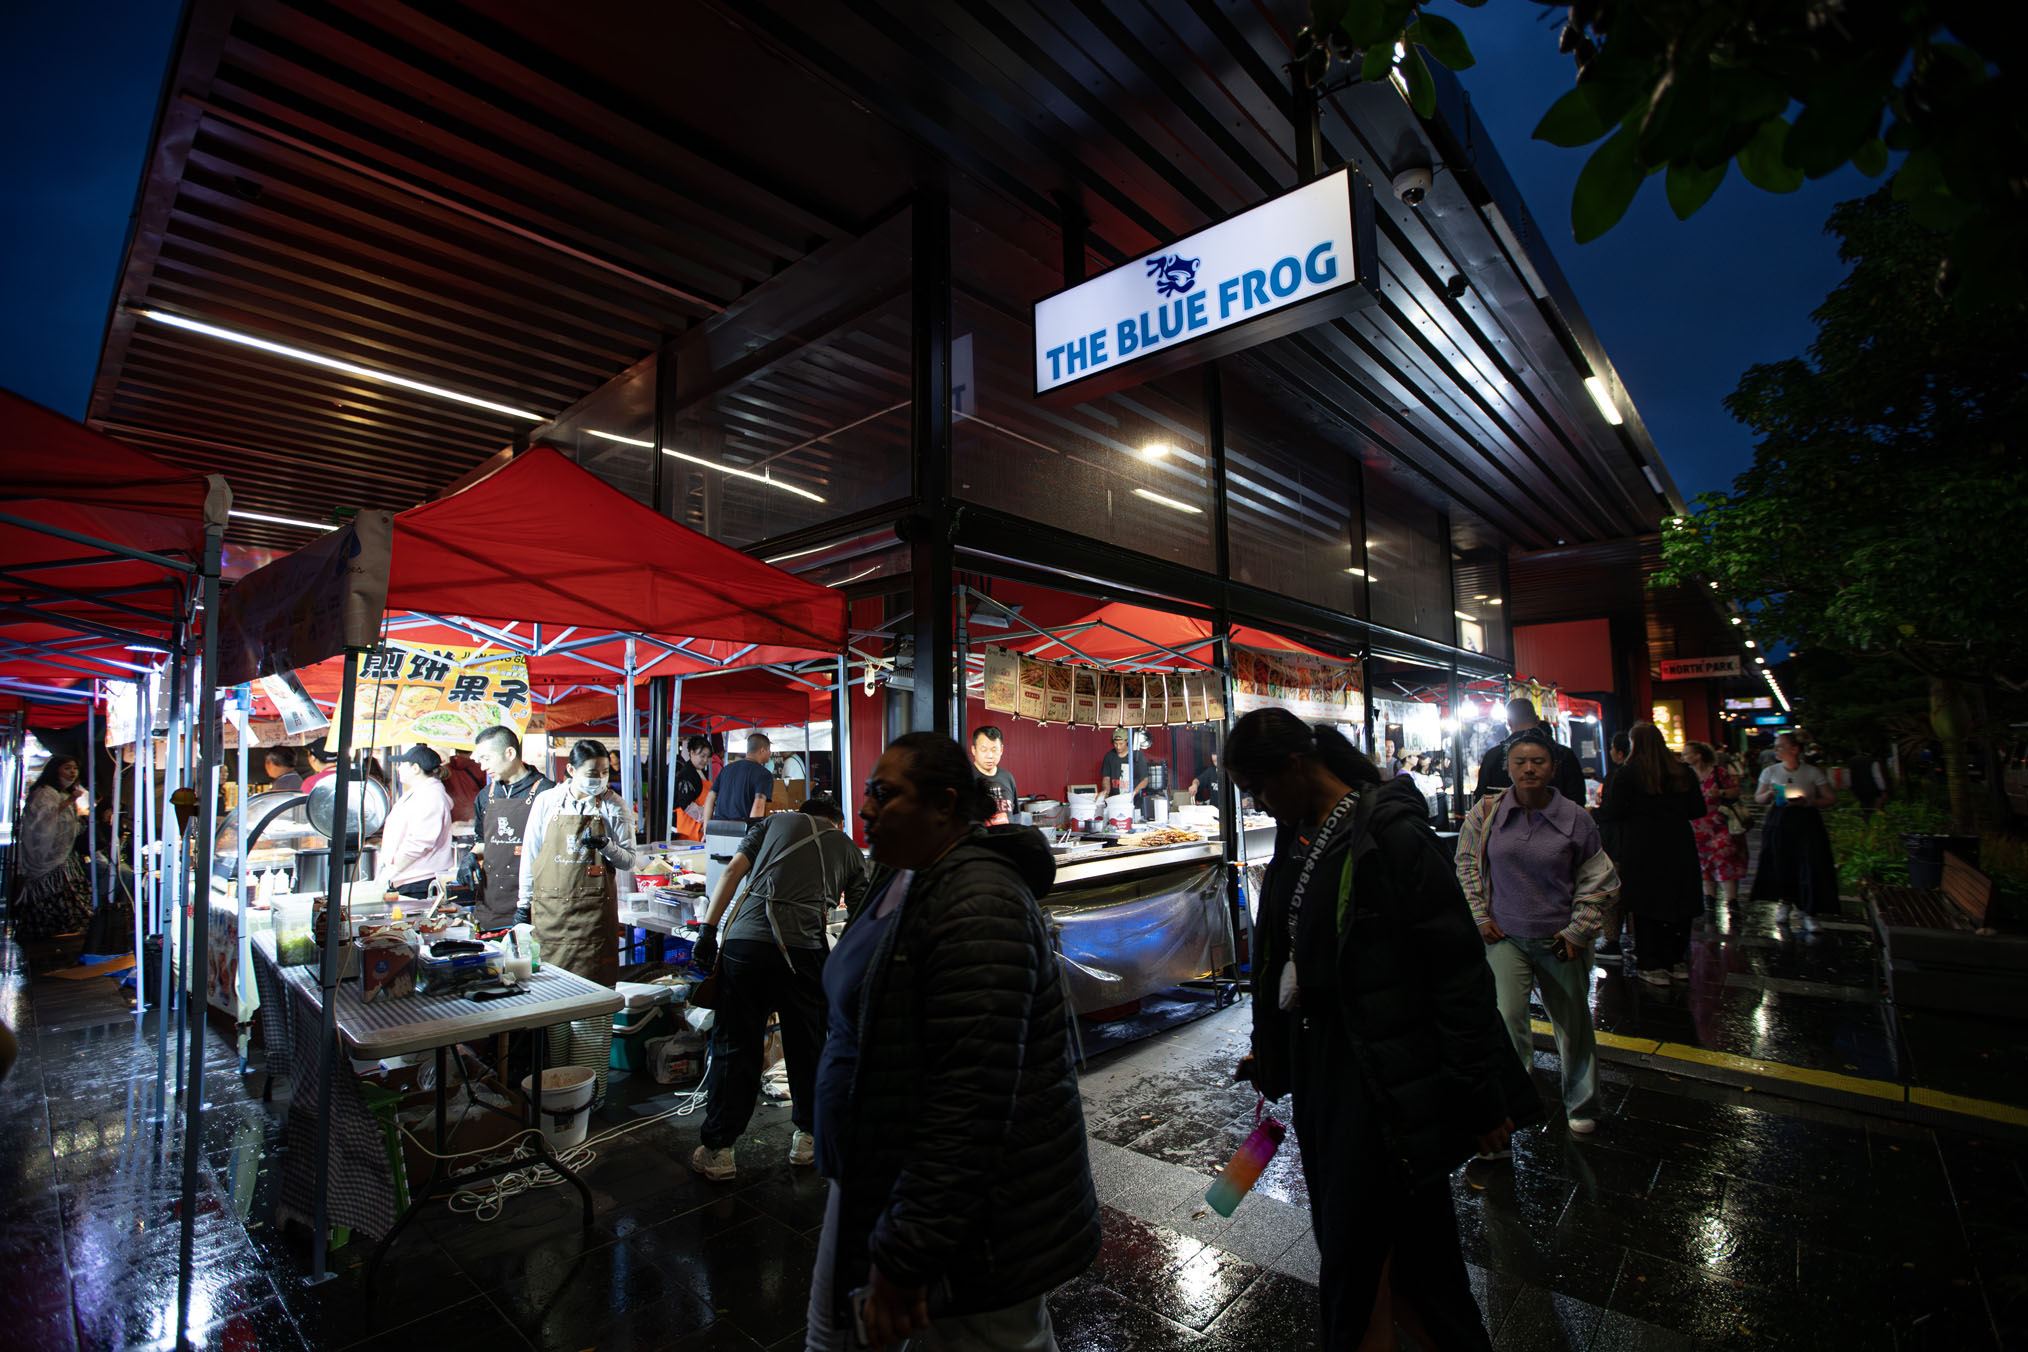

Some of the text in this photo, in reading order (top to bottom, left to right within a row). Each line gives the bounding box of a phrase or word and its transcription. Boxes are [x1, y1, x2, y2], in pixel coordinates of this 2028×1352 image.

[1046, 240, 1338, 381] THE BLUE FROG
[1669, 663, 1703, 675] NORTH
[1705, 661, 1734, 673] PARK
